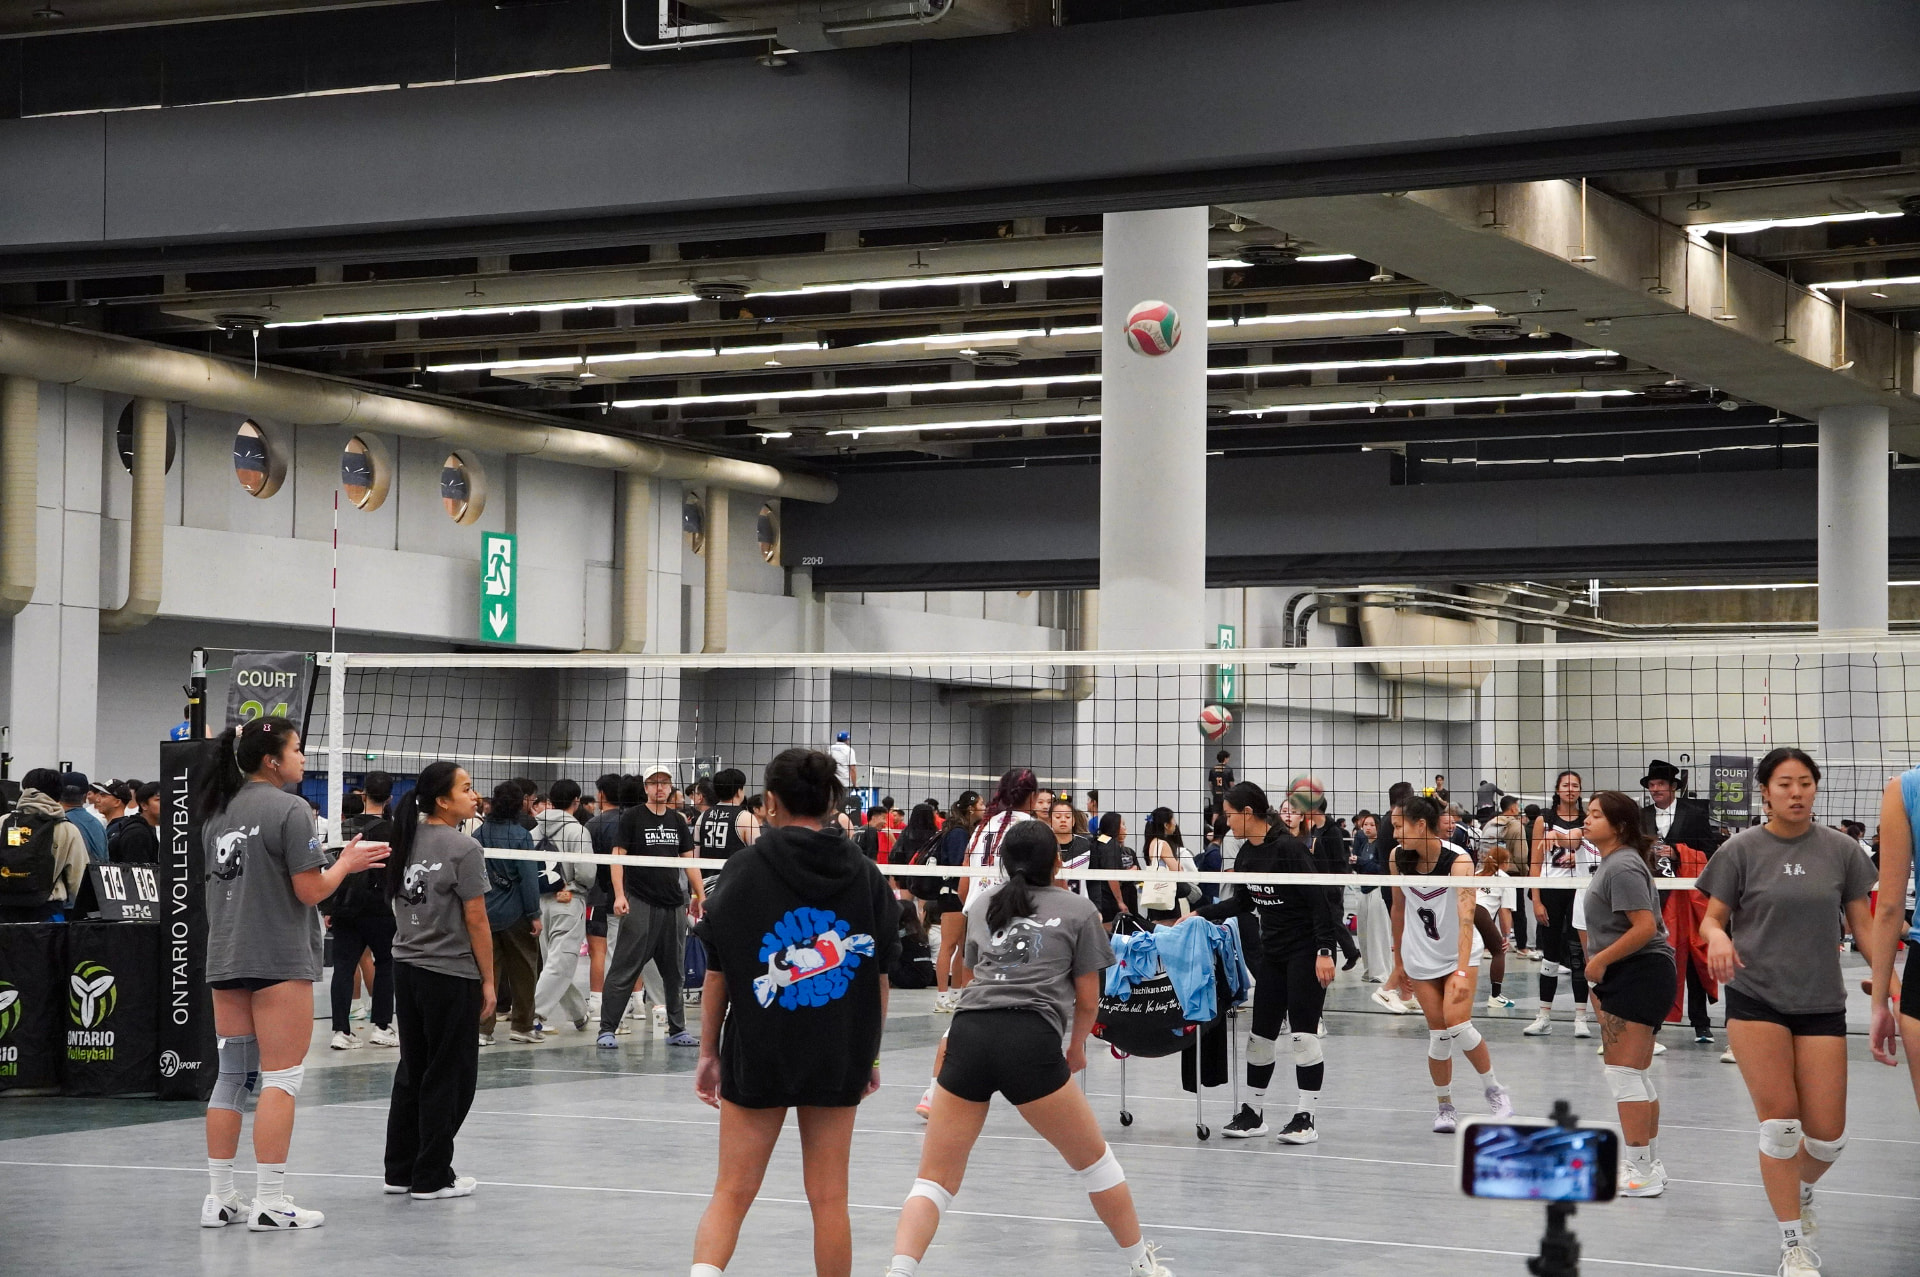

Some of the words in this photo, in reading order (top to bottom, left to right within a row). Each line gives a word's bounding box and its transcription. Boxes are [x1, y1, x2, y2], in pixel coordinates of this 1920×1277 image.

[237, 670, 297, 688] COURT
[1714, 768, 1748, 778] COURT
[1714, 781, 1744, 803] 25
[172, 767, 189, 916] VOLLEYBALL
[704, 820, 729, 849] 39
[1416, 907, 1440, 941] 8
[172, 921, 189, 1026] ONTARIO
[68, 1031, 115, 1047] ONTARIO
[67, 1047, 114, 1063] Volleyball
[179, 1061, 202, 1070] SPORT
